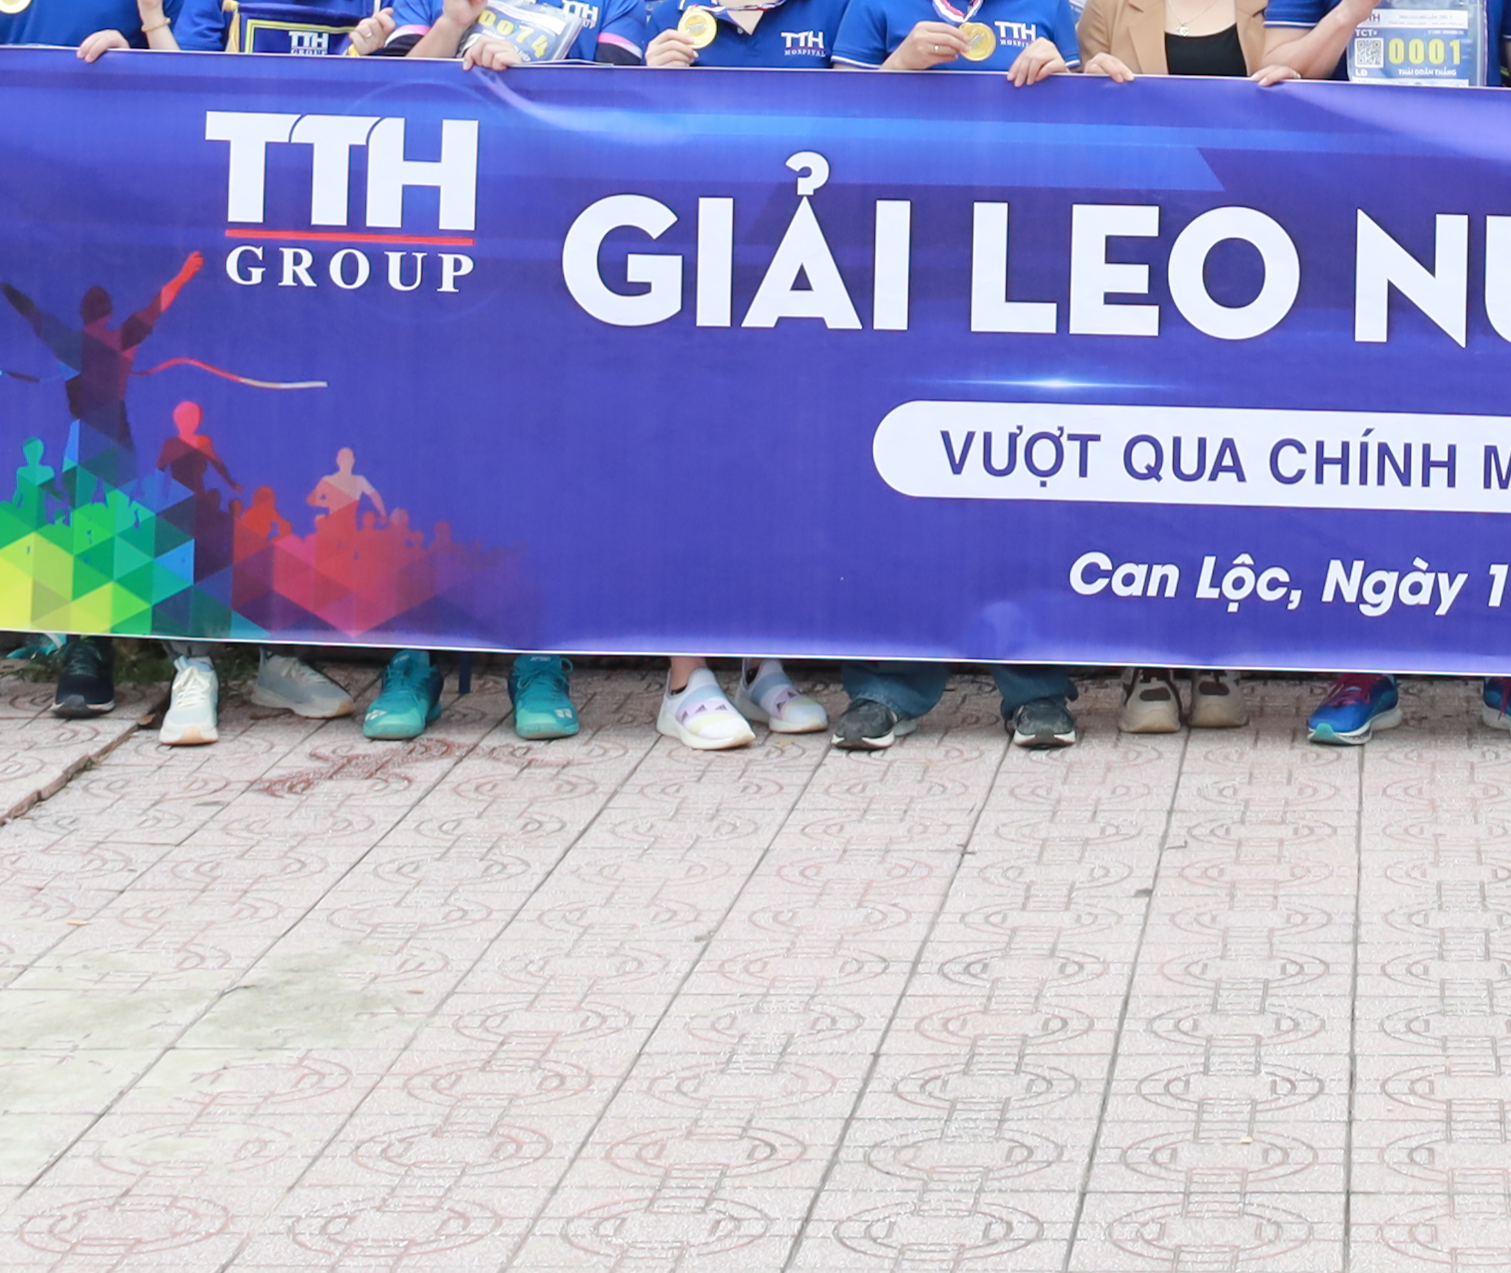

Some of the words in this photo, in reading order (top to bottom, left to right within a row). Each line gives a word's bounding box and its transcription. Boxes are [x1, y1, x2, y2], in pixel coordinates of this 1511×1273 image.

[289, 31, 329, 49] TTH
[478, 10, 549, 59] 0074
[781, 31, 824, 49] TTH
[995, 21, 1036, 40] TTH
[1388, 37, 1462, 65] 0001
[205, 111, 479, 230] TTH
[224, 245, 474, 293] GROUP
[561, 151, 911, 331] GIẢI
[970, 201, 1300, 342] LEO
[940, 424, 1101, 488] VƯỢT
[1122, 434, 1247, 483] QUA
[1269, 427, 1458, 488] CHÍNH
[1068, 550, 1179, 600] Can
[1196, 552, 1302, 613] Lộc,
[1322, 556, 1468, 616] Ngày
